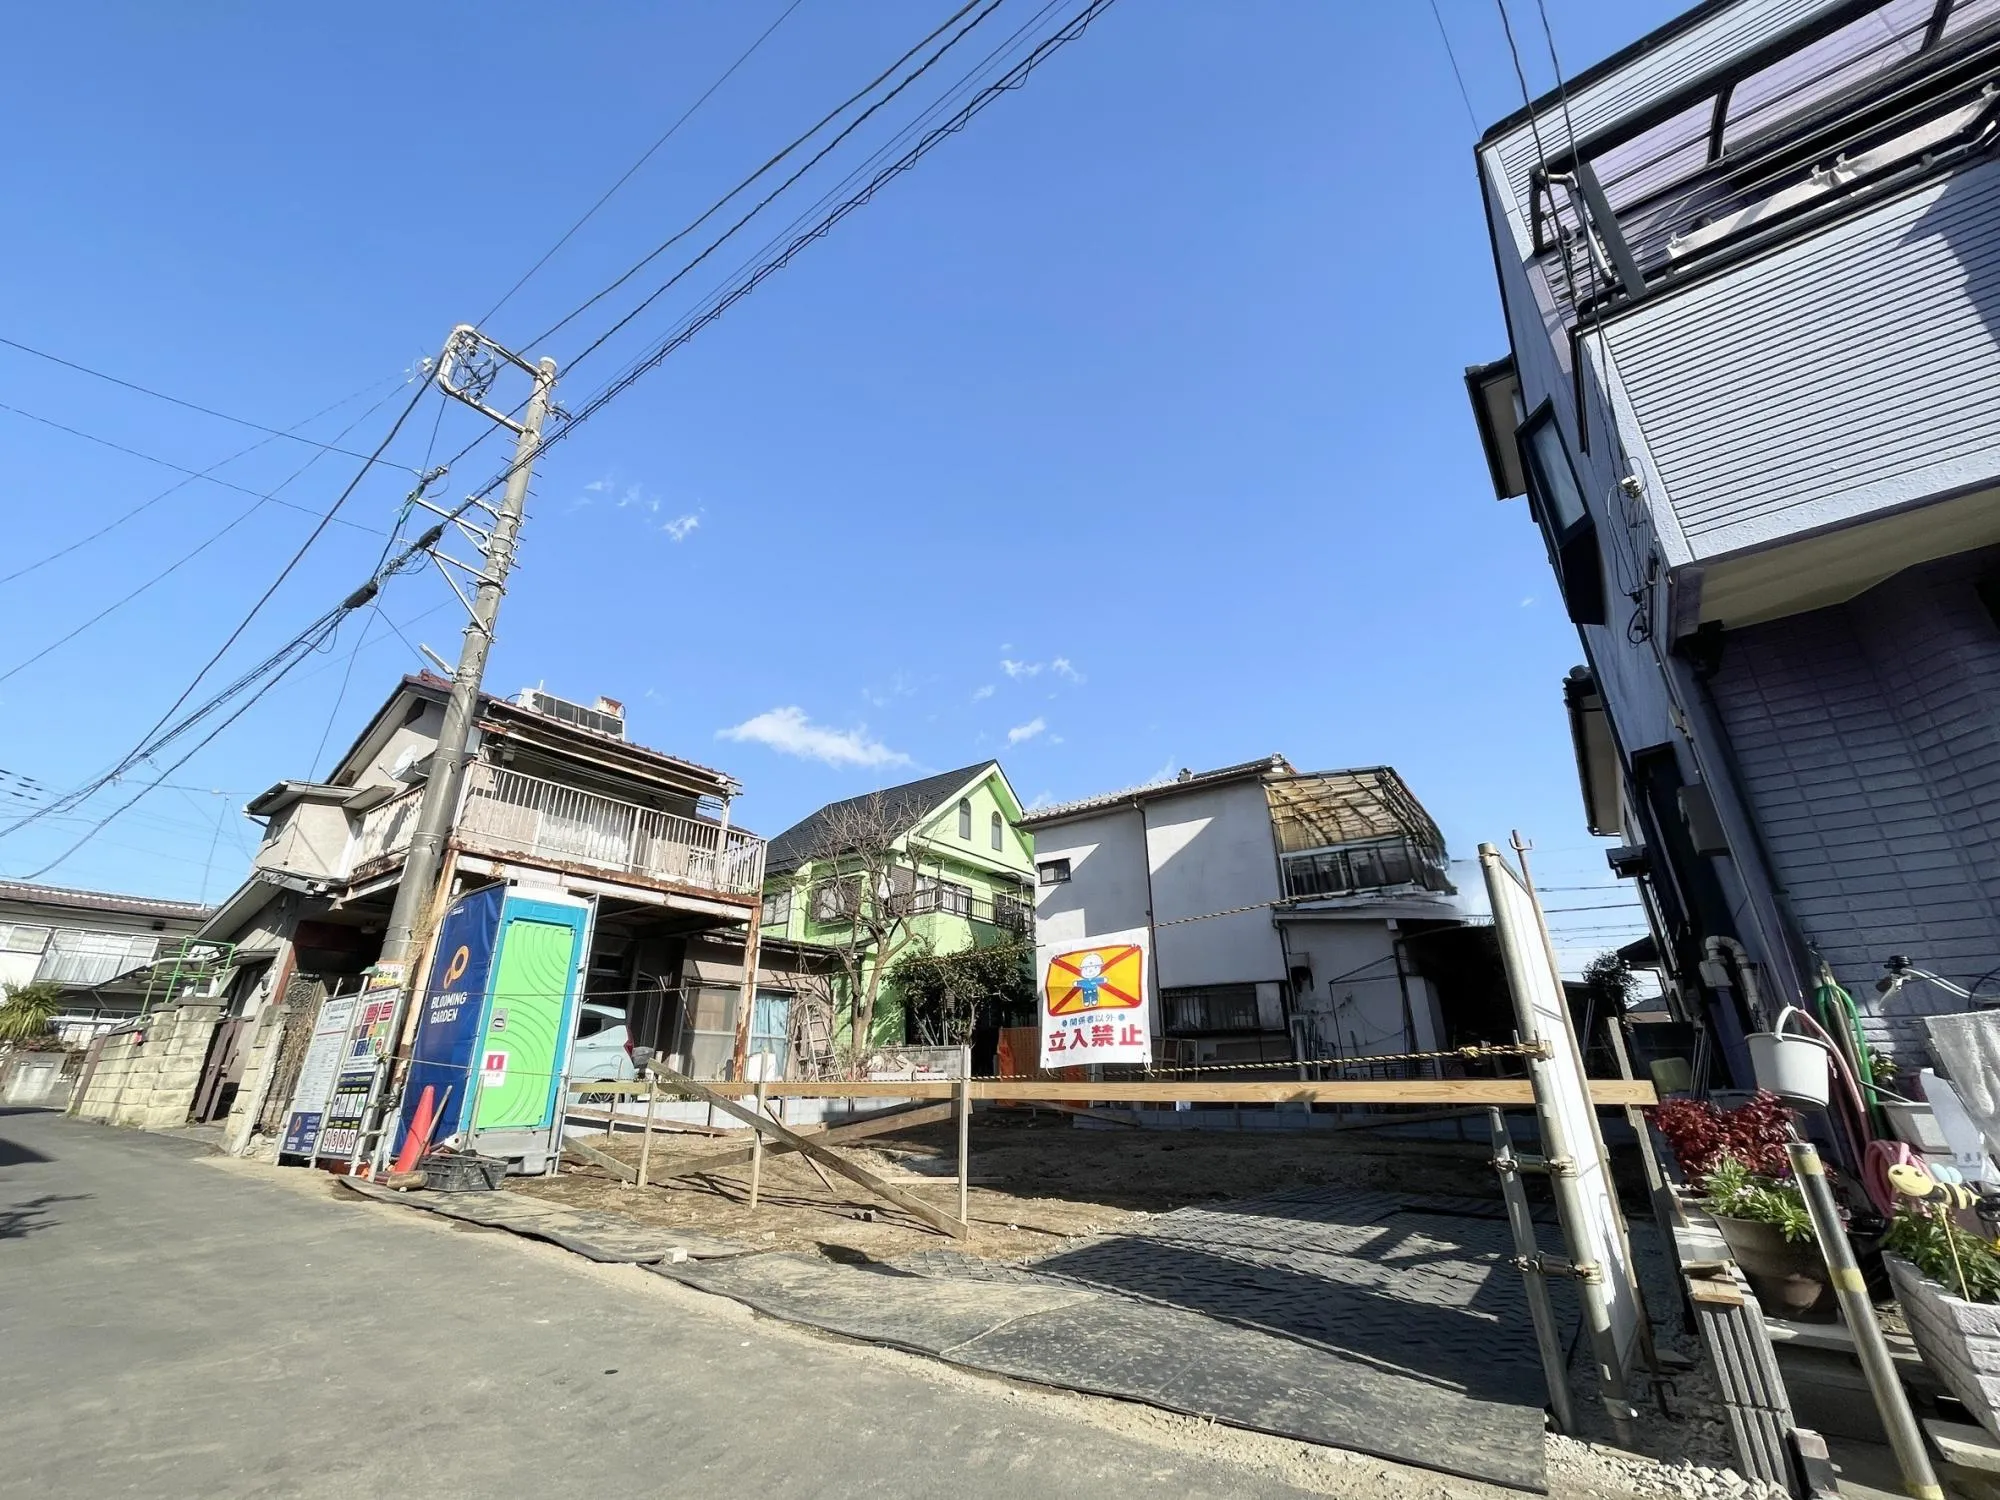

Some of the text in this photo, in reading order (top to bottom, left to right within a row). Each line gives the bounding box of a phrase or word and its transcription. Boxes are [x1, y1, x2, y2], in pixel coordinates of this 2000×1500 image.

[431, 992, 467, 1009] BLOOMING
[431, 1008, 458, 1024] GARDEN
[1070, 1014, 1115, 1027] 関係者以外
[1048, 1024, 1143, 1052] 立入禁止
